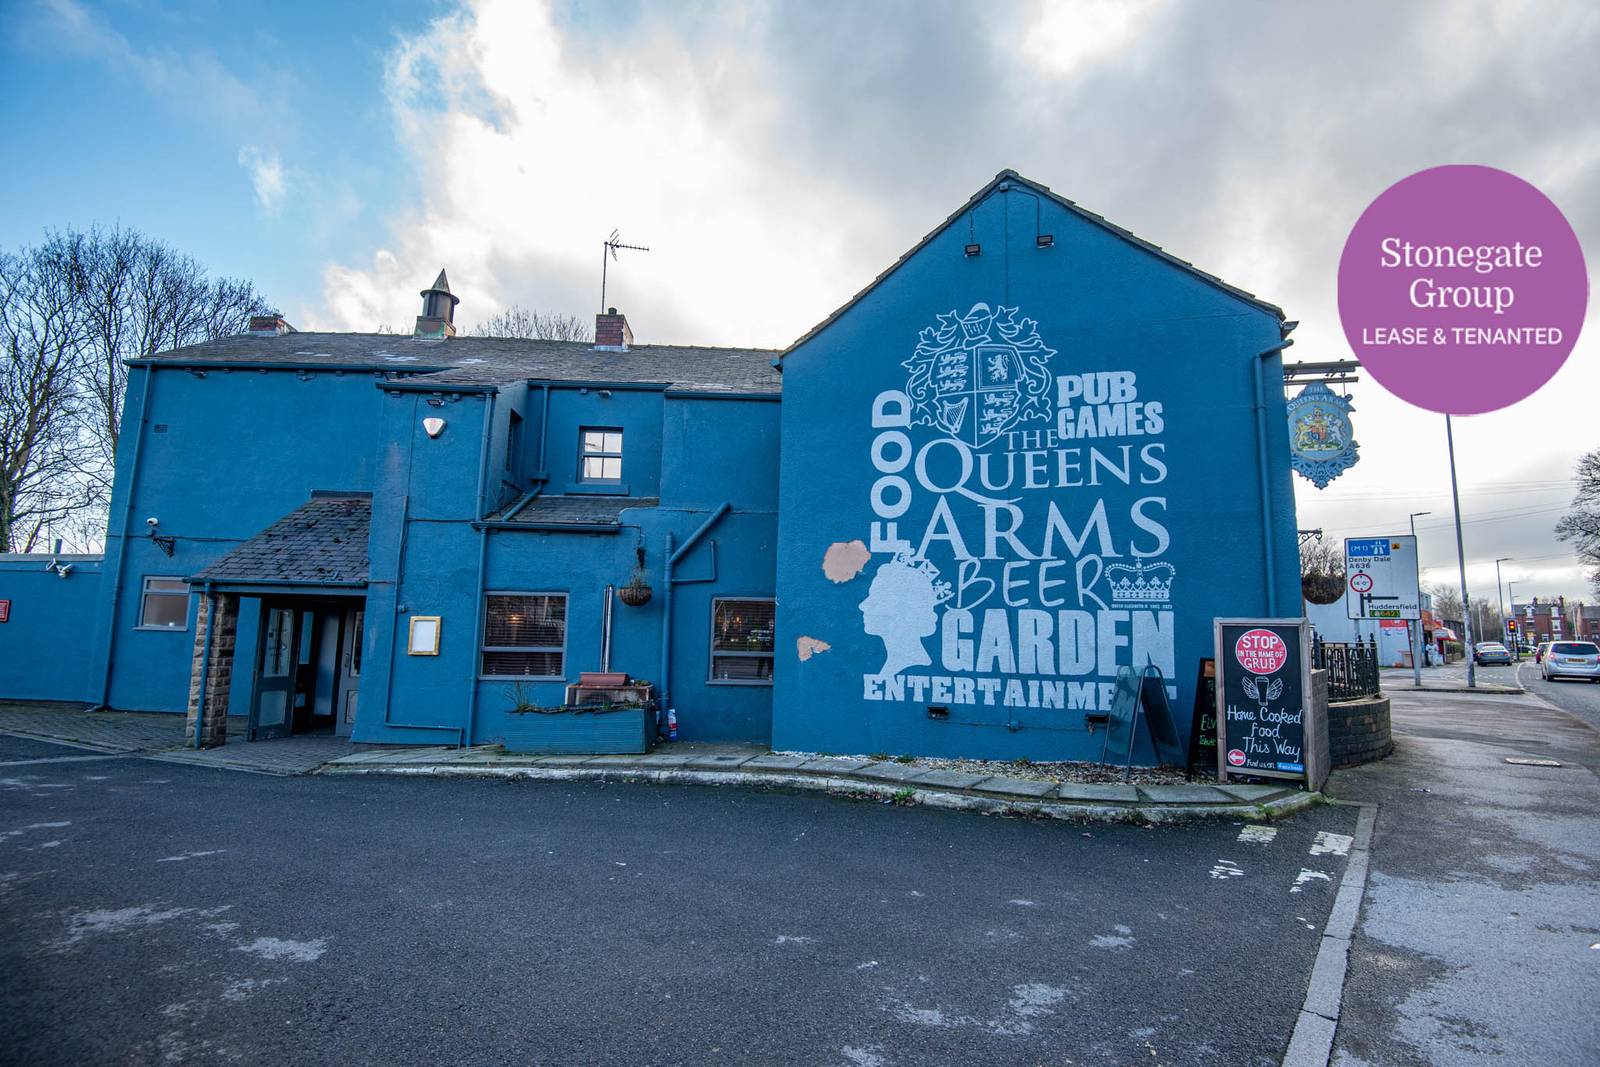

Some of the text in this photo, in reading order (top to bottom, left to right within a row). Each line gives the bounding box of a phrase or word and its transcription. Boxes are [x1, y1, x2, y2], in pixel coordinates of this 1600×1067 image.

[1056, 370, 1137, 406] PUB
[1002, 429, 1058, 450] THE
[1057, 401, 1165, 440] GAMES
[870, 389, 912, 553] FOOD
[915, 438, 1168, 504] QUEENS
[914, 494, 1170, 561] ARMS
[945, 554, 1109, 611] BEER
[942, 608, 1175, 679] GARDEN
[1242, 635, 1279, 649] STOP
[1244, 657, 1276, 670] GRUB
[864, 673, 1176, 711] ENTERTAINME
[1227, 704, 1303, 724] Home Cooked
[1242, 735, 1301, 763] This Way
